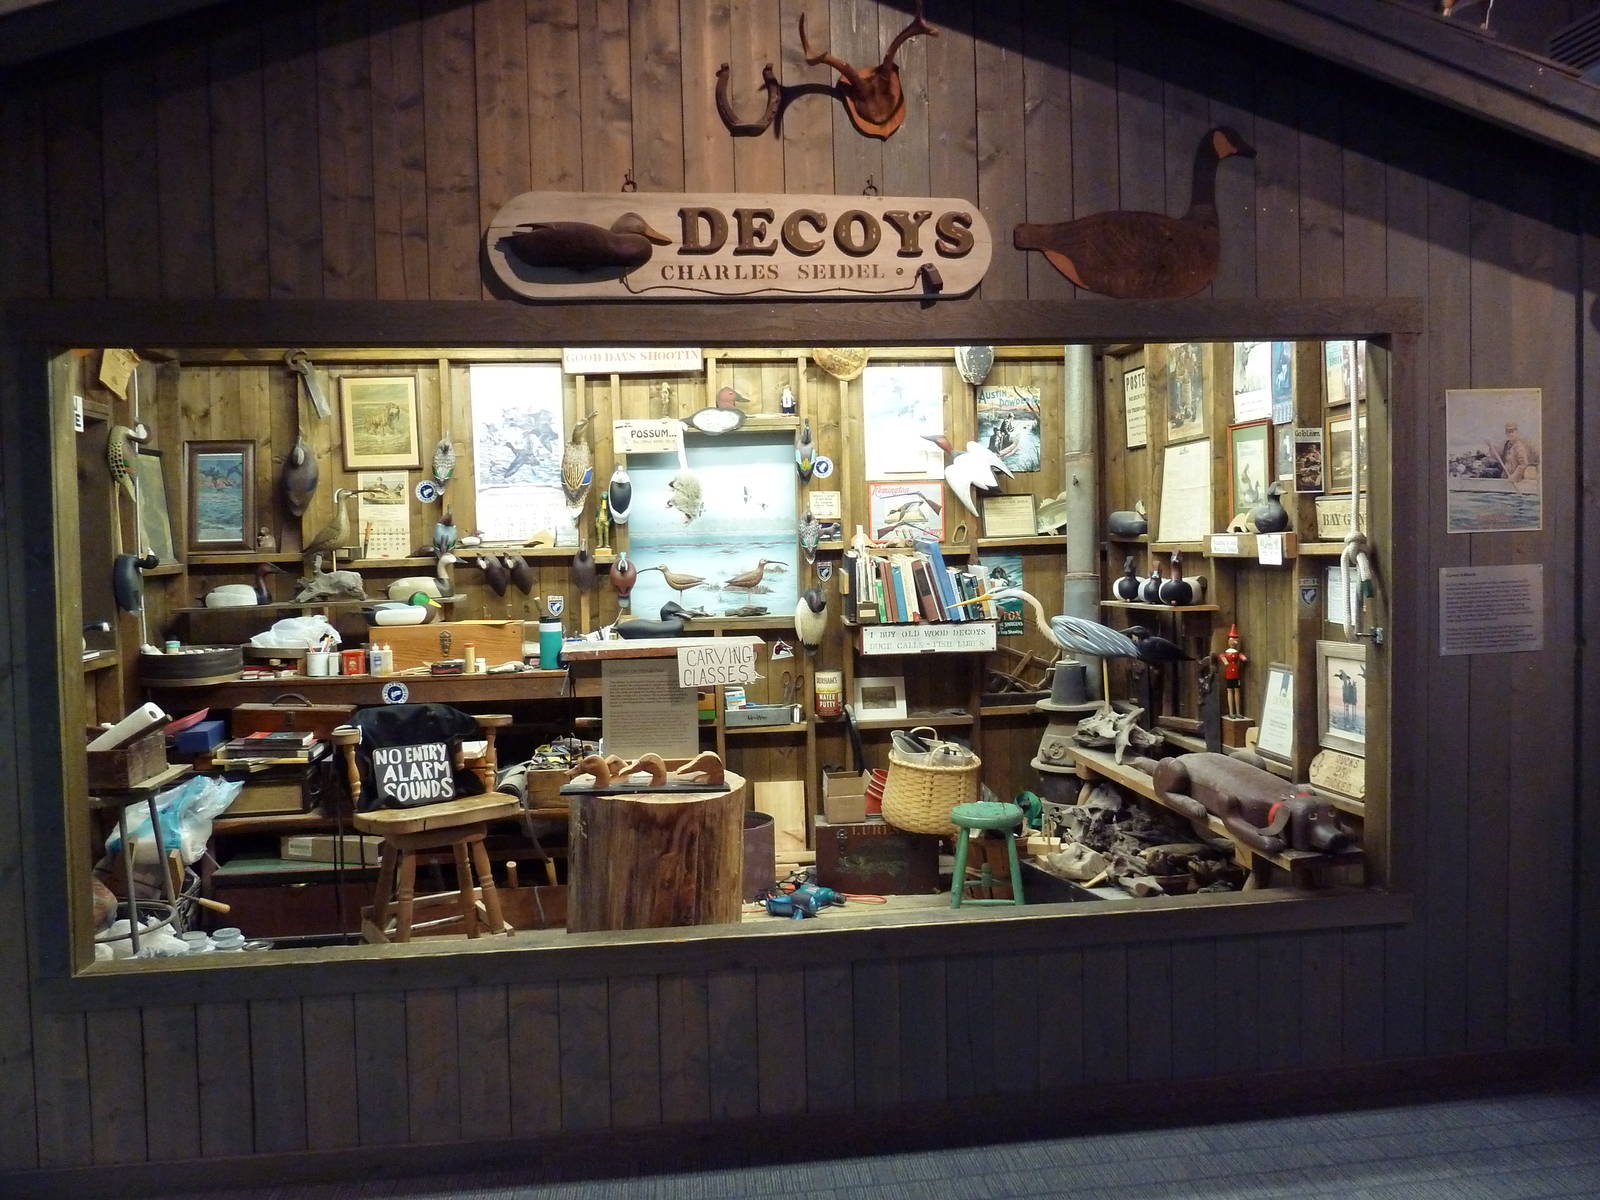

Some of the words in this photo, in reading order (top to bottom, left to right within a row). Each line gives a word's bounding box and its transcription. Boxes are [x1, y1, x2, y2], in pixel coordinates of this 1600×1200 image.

[677, 206, 976, 258] DECOYS
[660, 263, 780, 281] CHARLES
[797, 262, 886, 280] SEIDEL
[566, 352, 602, 363] GOOD
[605, 351, 637, 362] DAYS
[1125, 372, 1146, 392] POSTE
[978, 389, 1007, 404] AUSTIN
[1322, 513, 1341, 526] BAY
[869, 631, 874, 639] I
[880, 631, 896, 639] BUY
[901, 630, 920, 638] OLD
[924, 630, 949, 638] WOOD
[953, 628, 986, 637] DECOYS
[897, 641, 924, 649] CALLS
[686, 645, 753, 667] CARVING
[683, 664, 749, 687] CLASSES
[375, 748, 402, 765] NO
[404, 743, 447, 763] ENTRY
[383, 760, 451, 783] ALARM
[383, 777, 454, 802] SOUNDS
